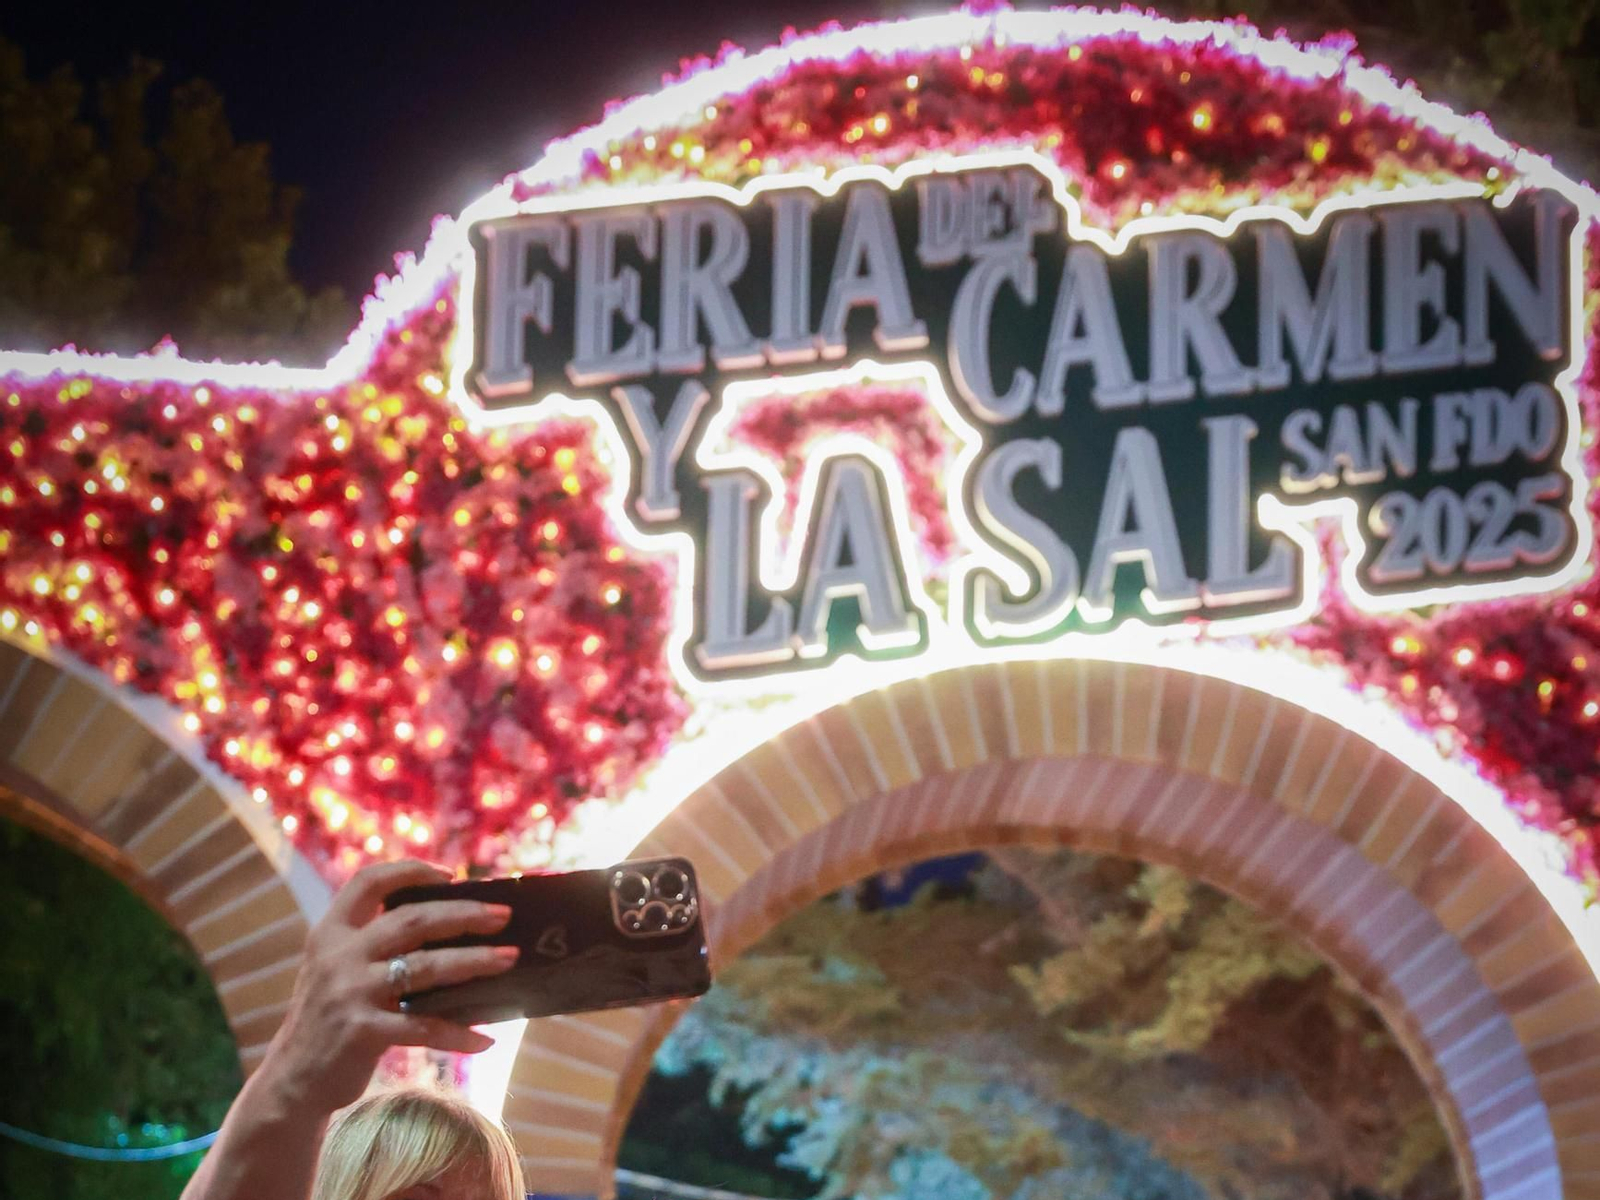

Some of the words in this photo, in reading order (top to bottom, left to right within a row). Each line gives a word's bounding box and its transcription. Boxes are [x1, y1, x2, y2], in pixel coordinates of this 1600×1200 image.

[475, 183, 930, 396] FERIA
[948, 188, 1576, 424] CARMEN
[610, 380, 710, 521] Y
[697, 457, 922, 670] LA
[972, 415, 1294, 639] SAL
[1279, 397, 1418, 494] SAN
[1430, 381, 1561, 472] FDO
[1368, 475, 1568, 581] 2025
